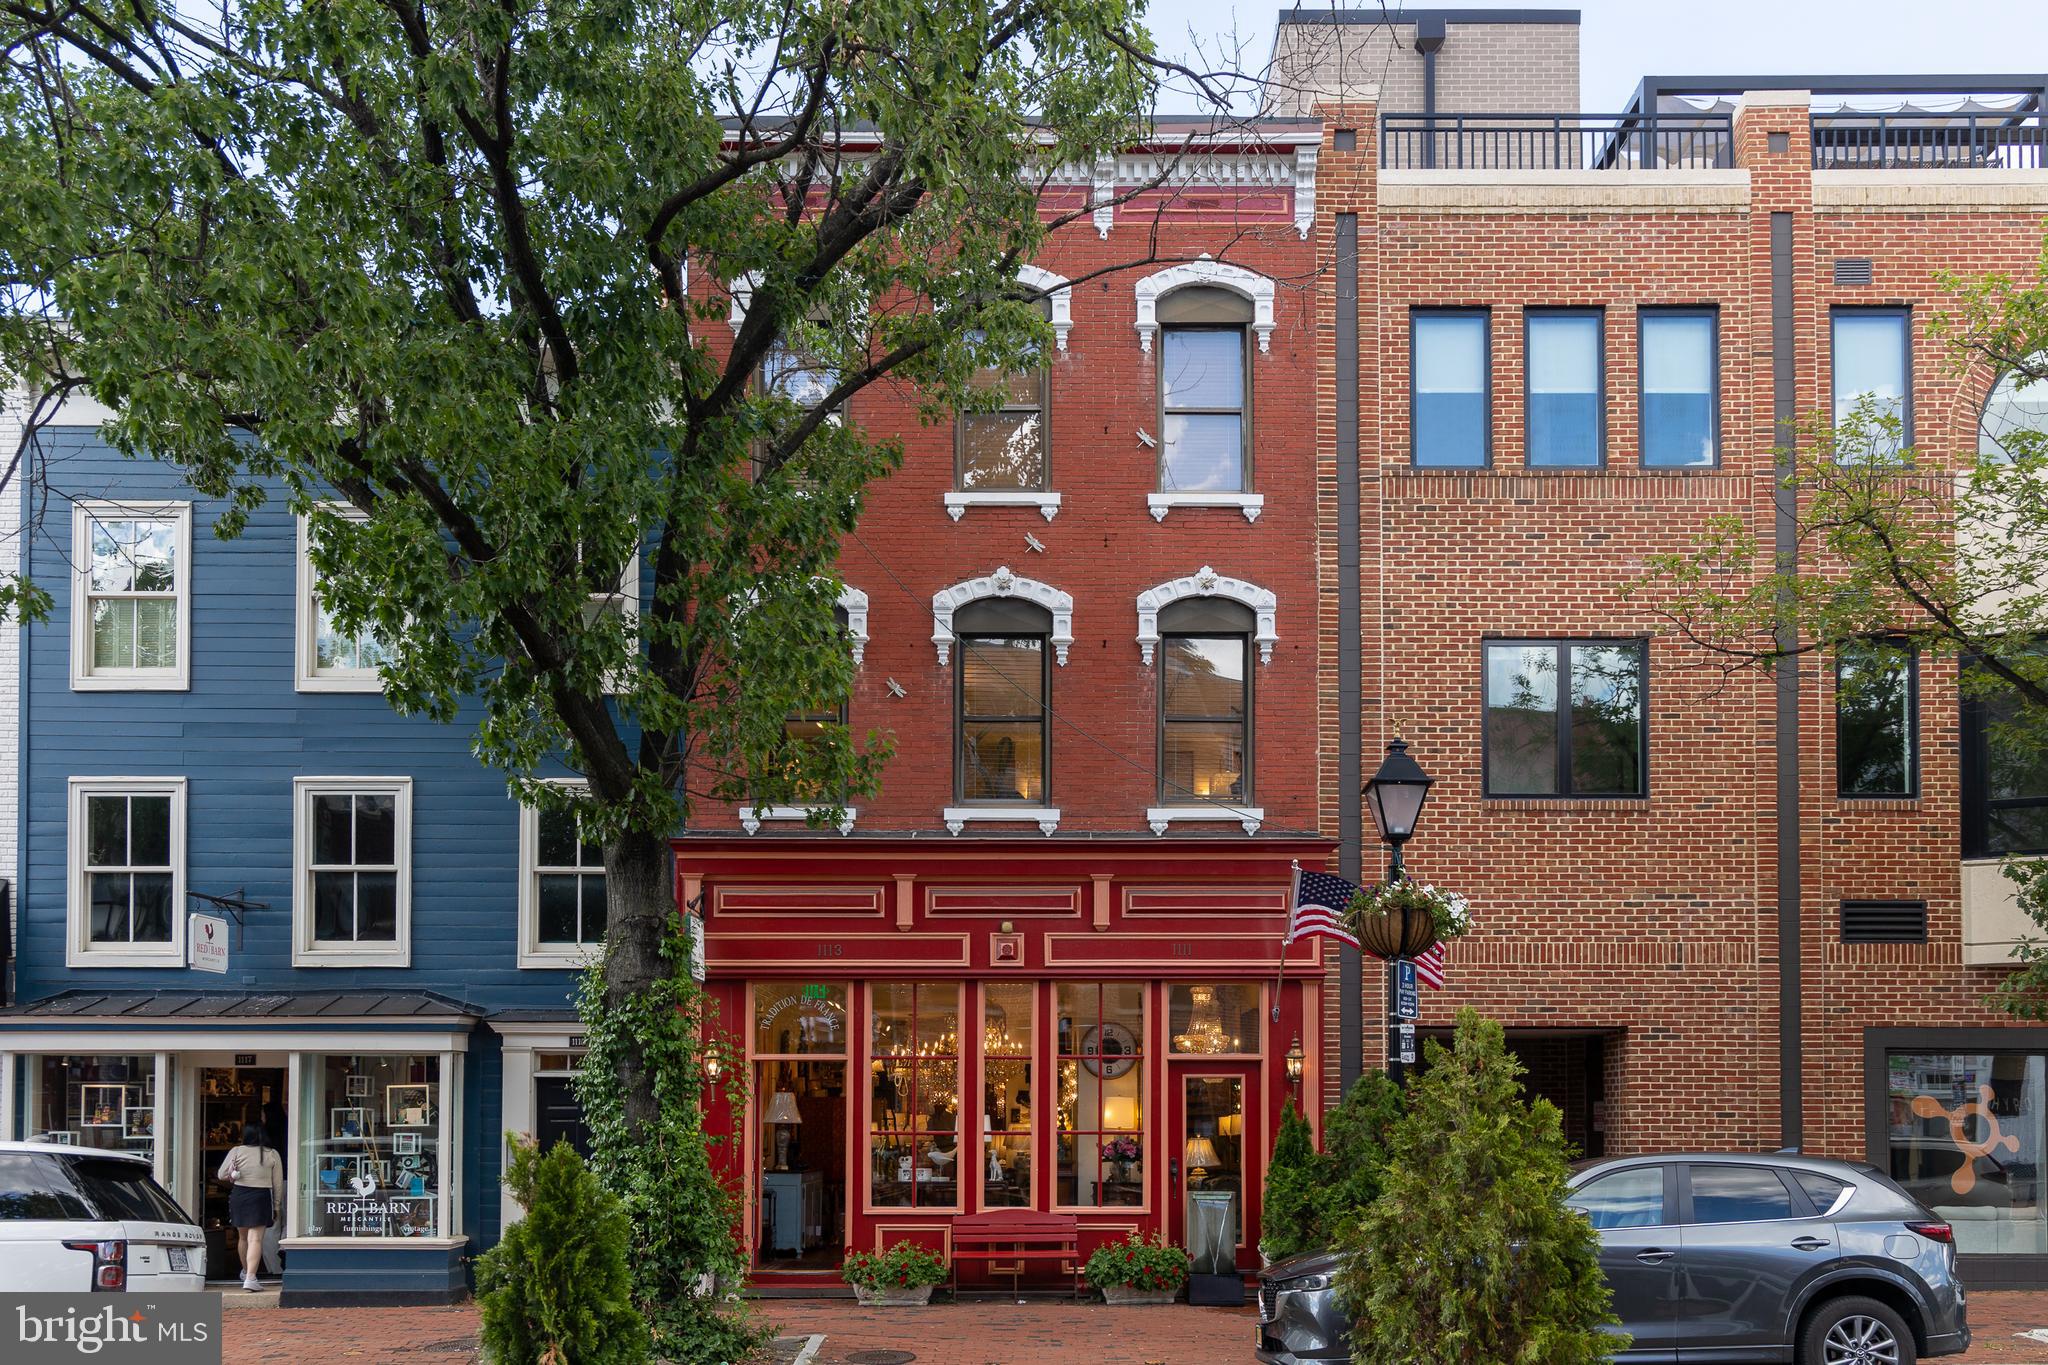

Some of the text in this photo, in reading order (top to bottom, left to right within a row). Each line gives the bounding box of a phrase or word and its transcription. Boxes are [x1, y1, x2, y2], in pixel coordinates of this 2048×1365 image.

[197, 943, 225, 956] RED BARN
[818, 944, 842, 956] 1113
[1404, 965, 1411, 981] P
[760, 995, 840, 1031] TRADITION DE FRANCE
[1087, 1047, 1094, 1055] 9
[1124, 1046, 1131, 1055] 3
[238, 1055, 253, 1064] 1117
[1106, 1065, 1113, 1074] 6
[327, 1202, 411, 1214] RED BARN
